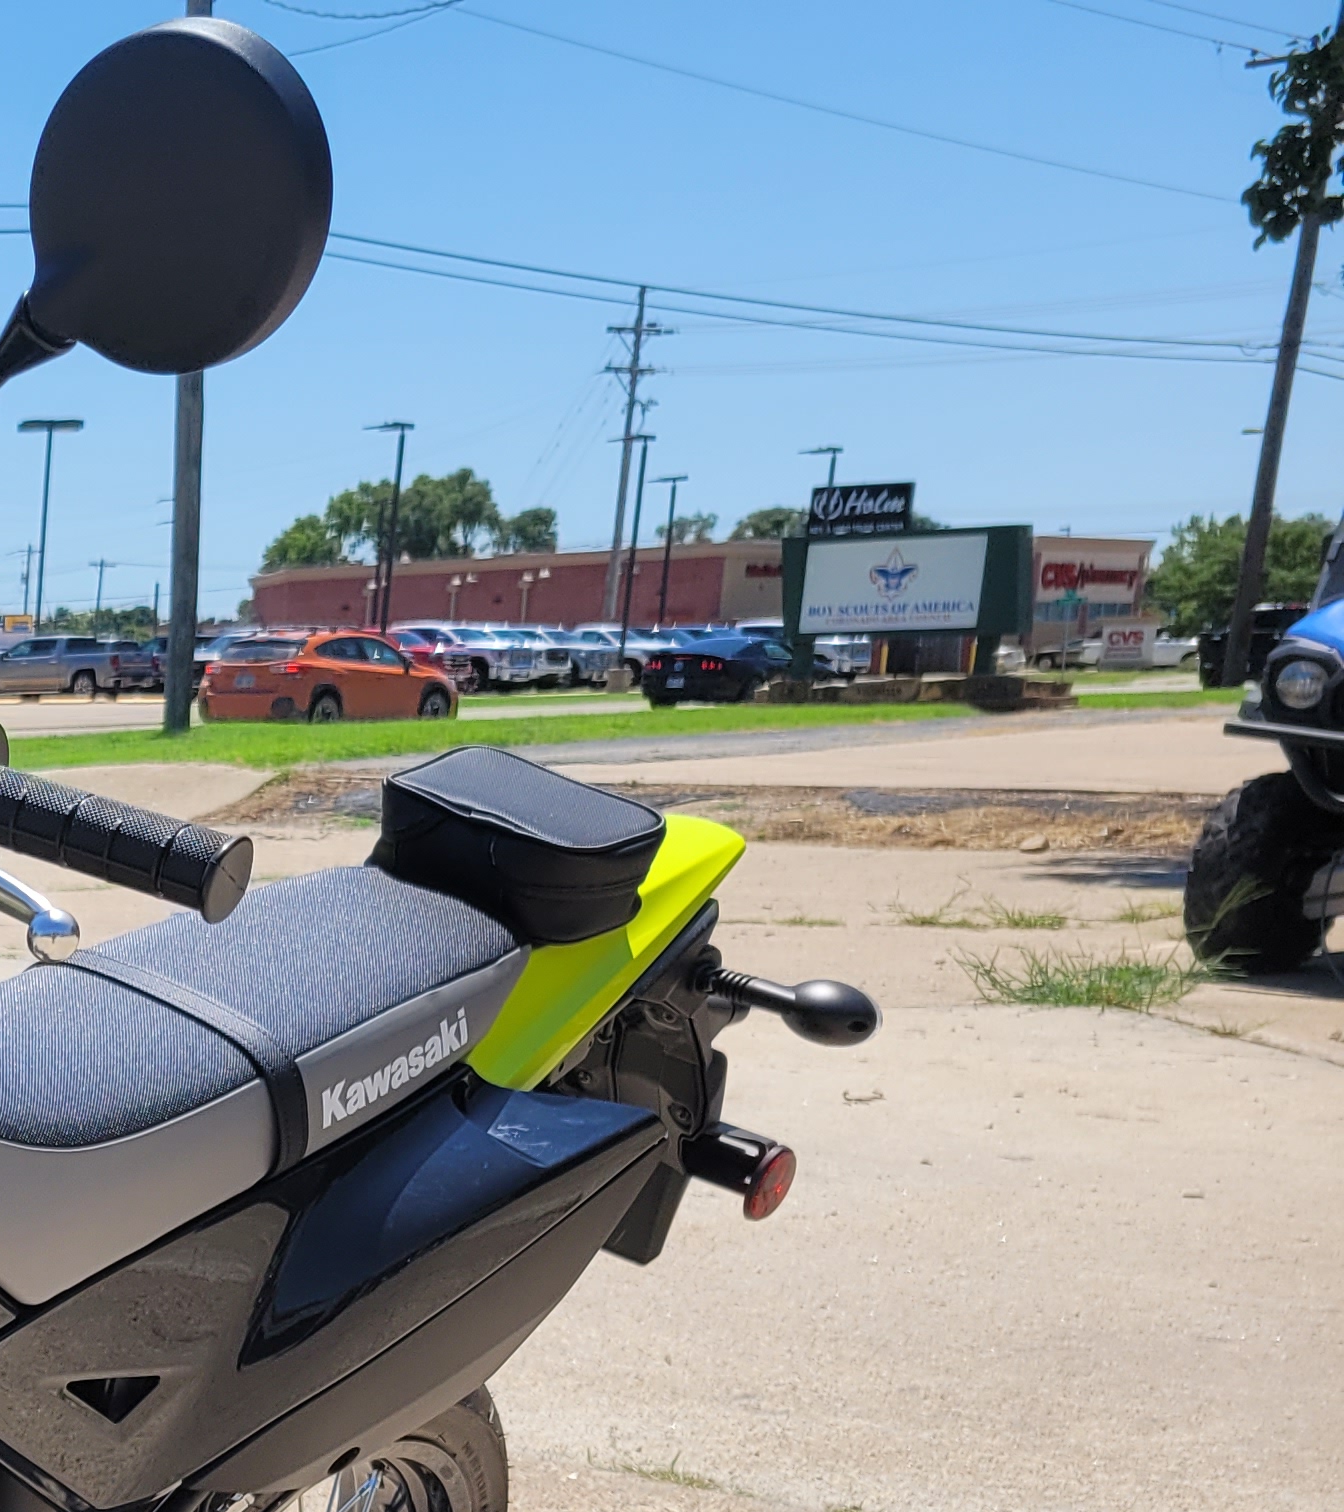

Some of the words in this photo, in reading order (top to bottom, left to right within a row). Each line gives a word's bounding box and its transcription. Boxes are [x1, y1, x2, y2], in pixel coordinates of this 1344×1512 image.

[844, 488, 906, 516] Holm
[808, 605, 833, 617] BOY
[838, 603, 888, 616] SCOUTS
[891, 602, 908, 613] OF
[912, 600, 975, 614] AMERICA
[1108, 631, 1145, 646] CVS
[321, 1006, 469, 1130] Kawasaki
